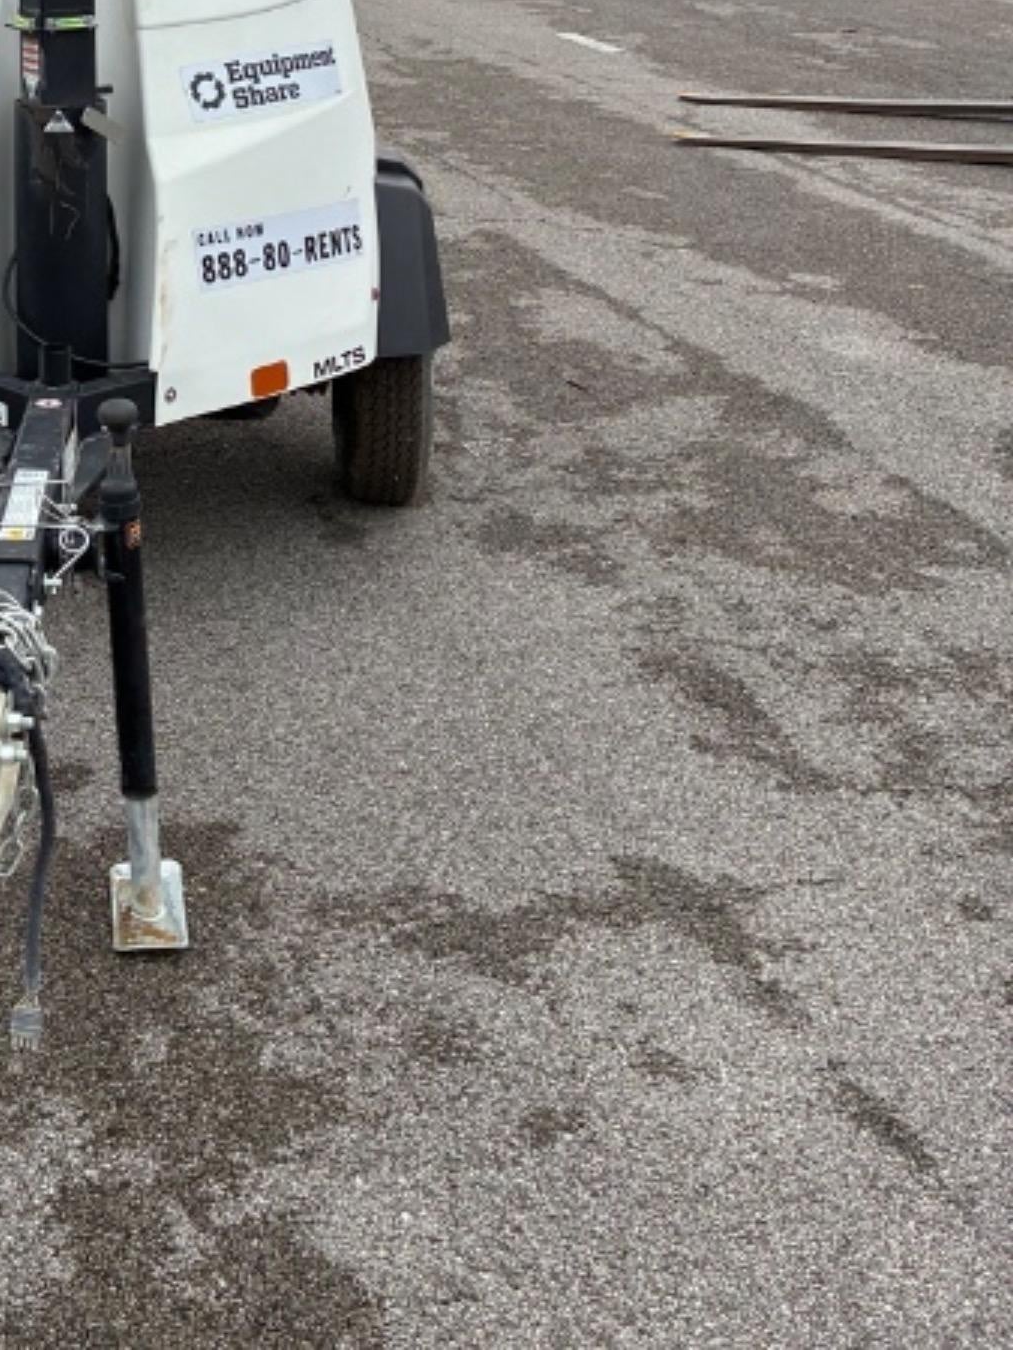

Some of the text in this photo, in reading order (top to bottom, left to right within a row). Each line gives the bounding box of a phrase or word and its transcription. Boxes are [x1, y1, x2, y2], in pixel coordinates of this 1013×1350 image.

[224, 46, 336, 84] Equipment
[232, 82, 300, 109] Share
[197, 229, 230, 247] CALL
[202, 224, 363, 284] 888-80-RENTS
[313, 344, 365, 379] MLTS
